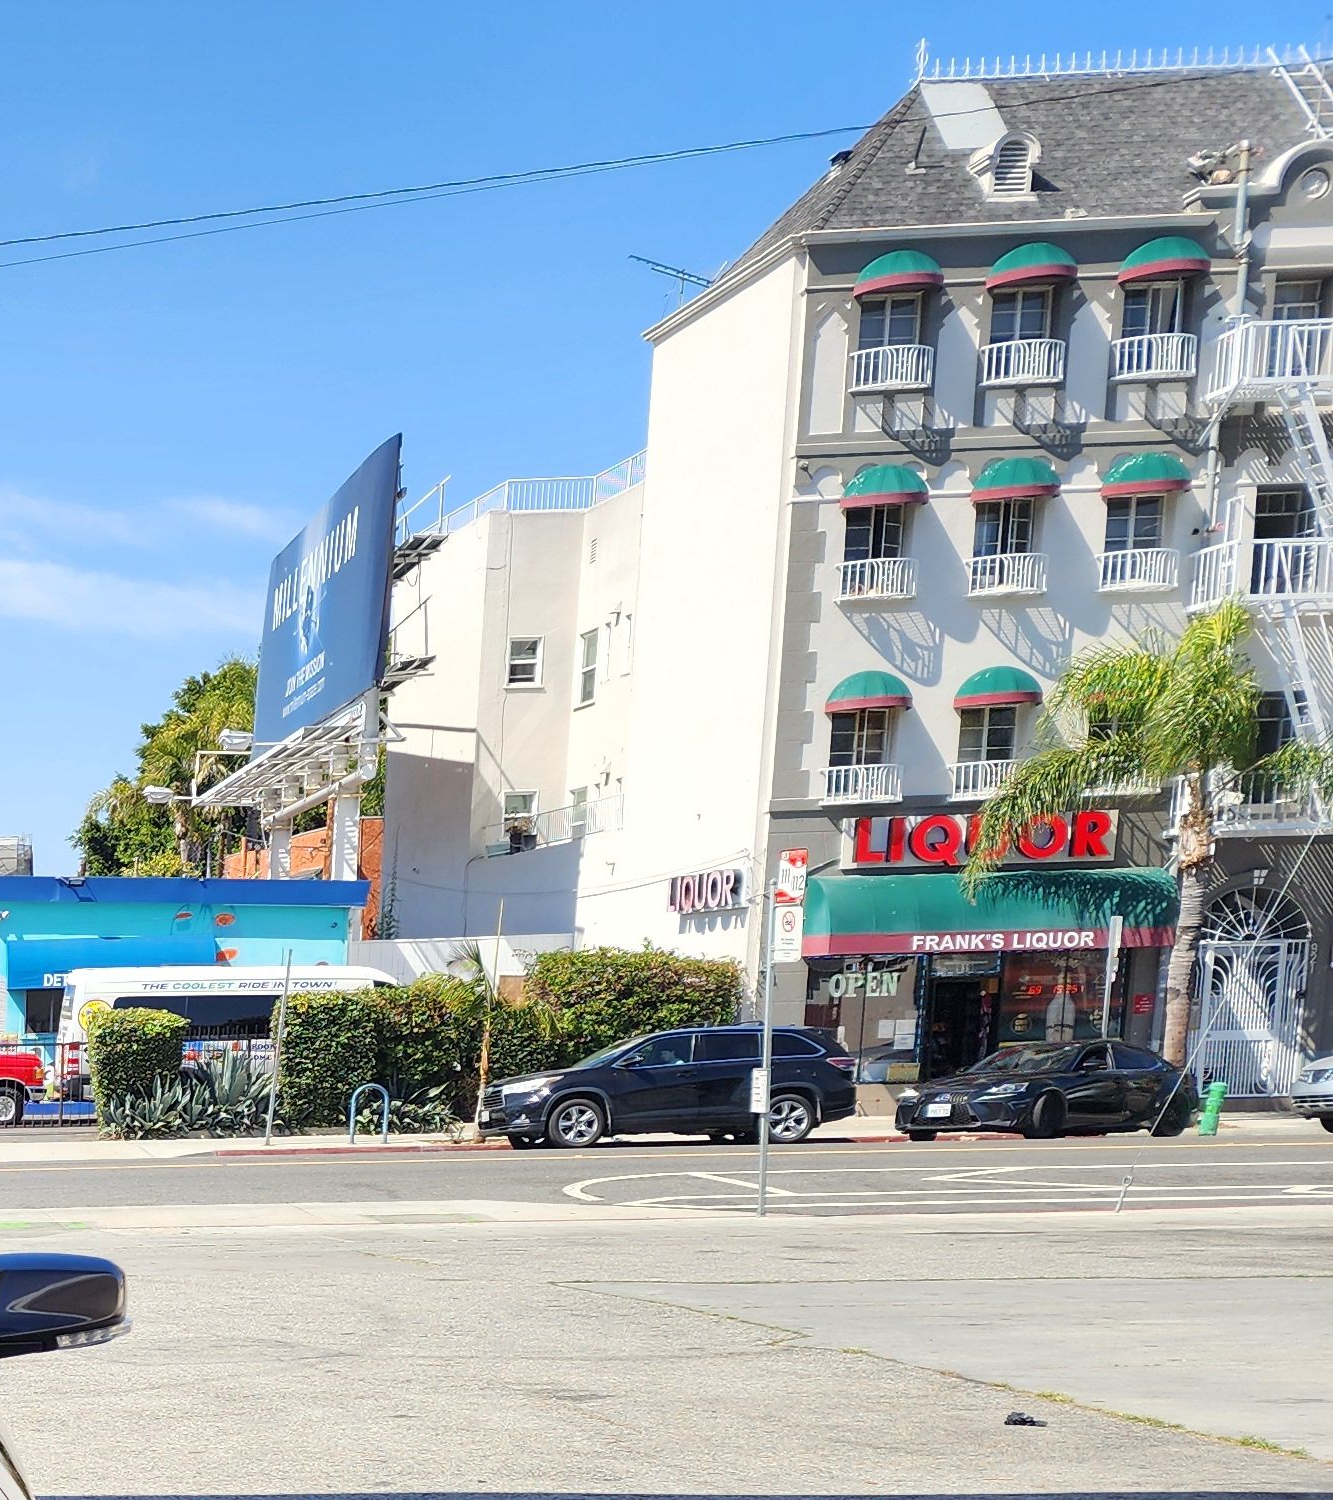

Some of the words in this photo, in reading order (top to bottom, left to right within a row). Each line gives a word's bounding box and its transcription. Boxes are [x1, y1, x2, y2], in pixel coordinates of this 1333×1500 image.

[272, 505, 359, 631] MILLENNIUM
[781, 868, 791, 884] 111
[792, 874, 805, 891] 112
[667, 869, 735, 914] LIQUOR
[1012, 931, 1095, 949] LIQUOR
[173, 982, 234, 990] COOLEST
[829, 972, 899, 998] OPEN
